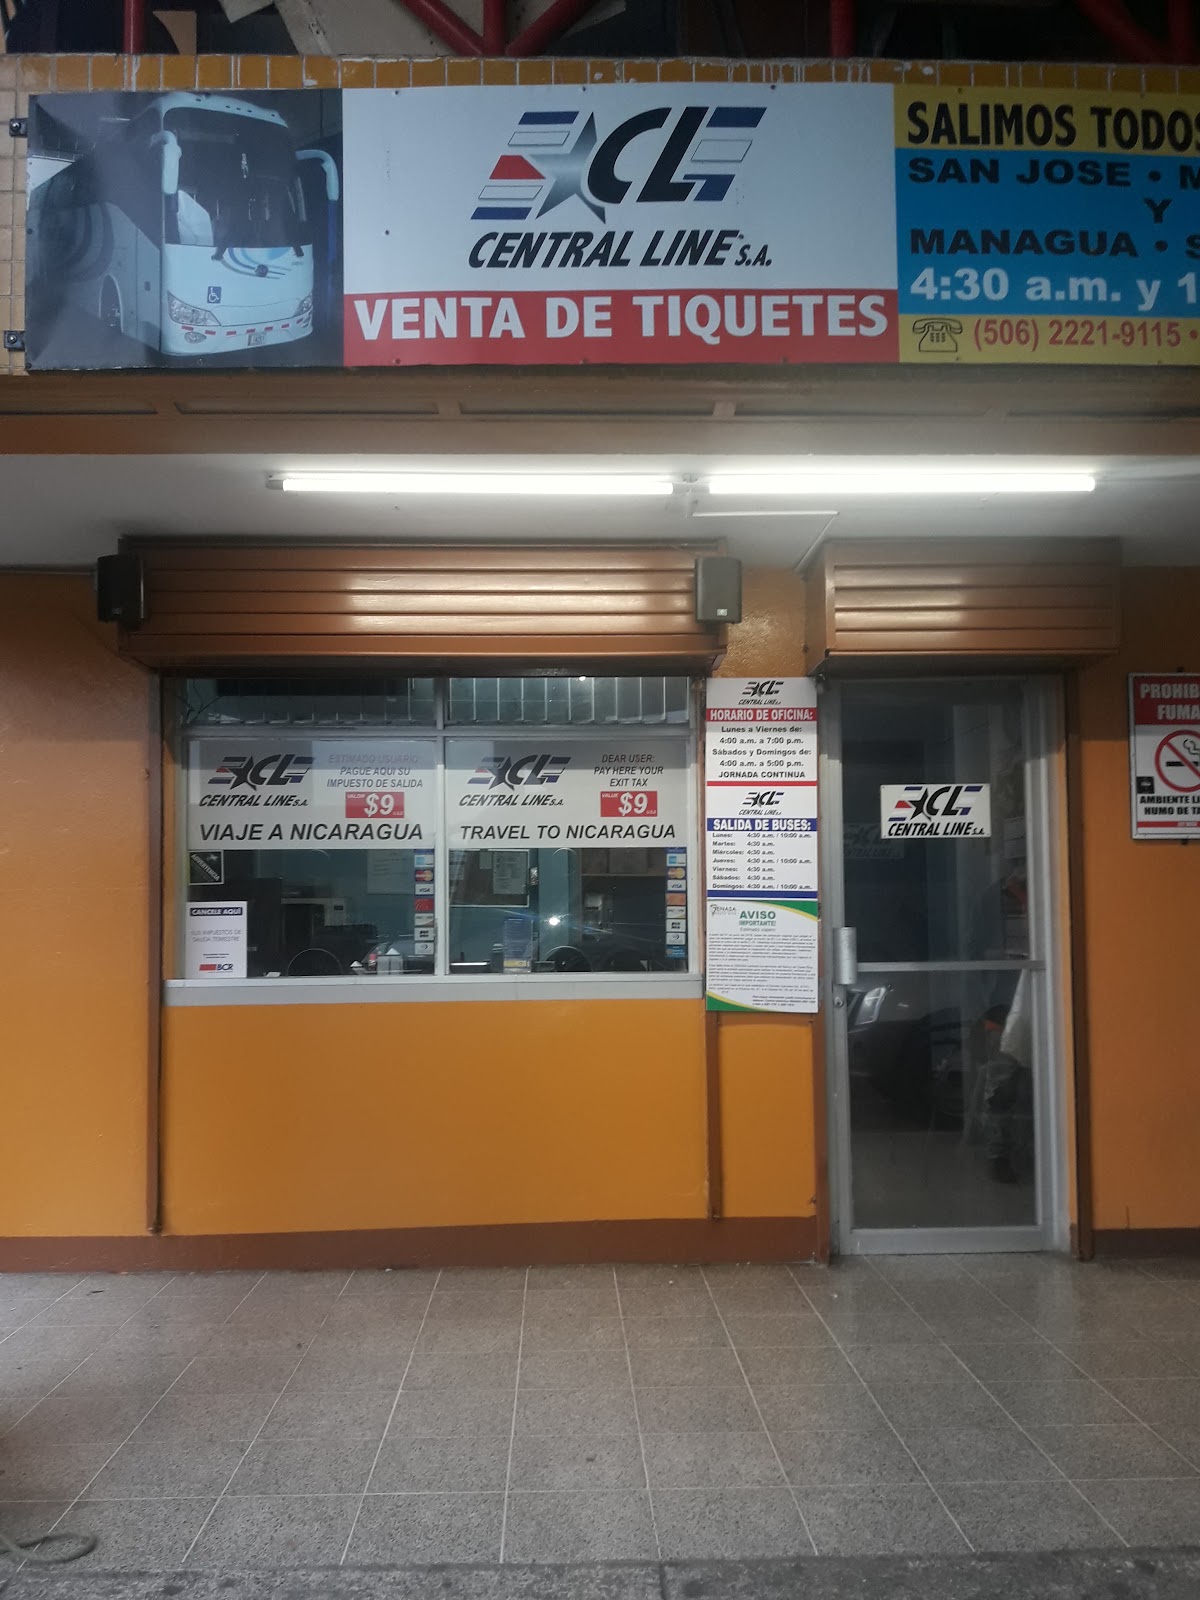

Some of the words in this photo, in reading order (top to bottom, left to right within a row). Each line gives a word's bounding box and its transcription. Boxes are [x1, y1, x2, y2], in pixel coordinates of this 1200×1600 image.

[907, 101, 1076, 146] SALIMOS
[1090, 106, 1200, 152] TODO
[908, 157, 999, 184] SAN
[1016, 159, 1131, 187] JOSE
[1144, 197, 1172, 223] Y
[468, 231, 634, 268] CENTRAL
[639, 229, 740, 267] LINE
[735, 244, 773, 266] S.A.
[910, 229, 1138, 257] MANAGUA
[910, 267, 1009, 301] 4:30
[1026, 275, 1121, 301] a.m.
[1137, 279, 1161, 311] y
[354, 297, 525, 341] VENTA
[545, 297, 612, 339] DE
[632, 295, 889, 345] TIQUETES
[974, 319, 1039, 351] (506)
[1048, 319, 1181, 347] 2221-9115
[1140, 683, 1200, 699] PROHIB
[710, 709, 753, 720] HORARIO
[756, 709, 768, 720] DE
[771, 709, 813, 720] OFICINA:
[1157, 704, 1200, 720] FUMA
[328, 754, 375, 763] ESTIMADO
[602, 754, 626, 763] DEAR
[629, 754, 656, 763] USER:
[340, 767, 371, 776] PAGUE
[372, 767, 396, 776] AQUI
[397, 767, 411, 776] SU
[594, 766, 611, 775] PAY
[612, 766, 637, 775] HERE
[639, 766, 664, 775] YOUR
[327, 779, 373, 788] IMPUESTO
[375, 779, 388, 788] DE
[390, 779, 423, 788] SALIDA
[609, 778, 630, 787] EXIT
[631, 778, 649, 787] TAX
[198, 795, 261, 807] CENTRAL
[263, 795, 297, 807] LINE
[292, 799, 309, 807] S.A.
[363, 792, 395, 818] $9
[458, 795, 520, 806] CENTRAL
[521, 795, 553, 806] LINE
[618, 792, 648, 817] $9
[1140, 796, 1189, 804] AMBIENTE
[1144, 807, 1174, 815] HUMO
[1177, 807, 1189, 815] DE
[200, 824, 264, 840] VIAJE
[267, 824, 283, 840] A
[290, 823, 423, 840] NICARAGUA
[460, 825, 530, 840] TRAVEL
[537, 825, 561, 840] TO
[566, 824, 675, 840] NICARAGUA
[713, 819, 752, 831] SALIDA
[755, 819, 769, 831] DE
[772, 819, 811, 831] BUSES:
[888, 823, 941, 836] CENTRAL
[942, 822, 974, 835] LINE
[739, 910, 776, 919] AVISO
